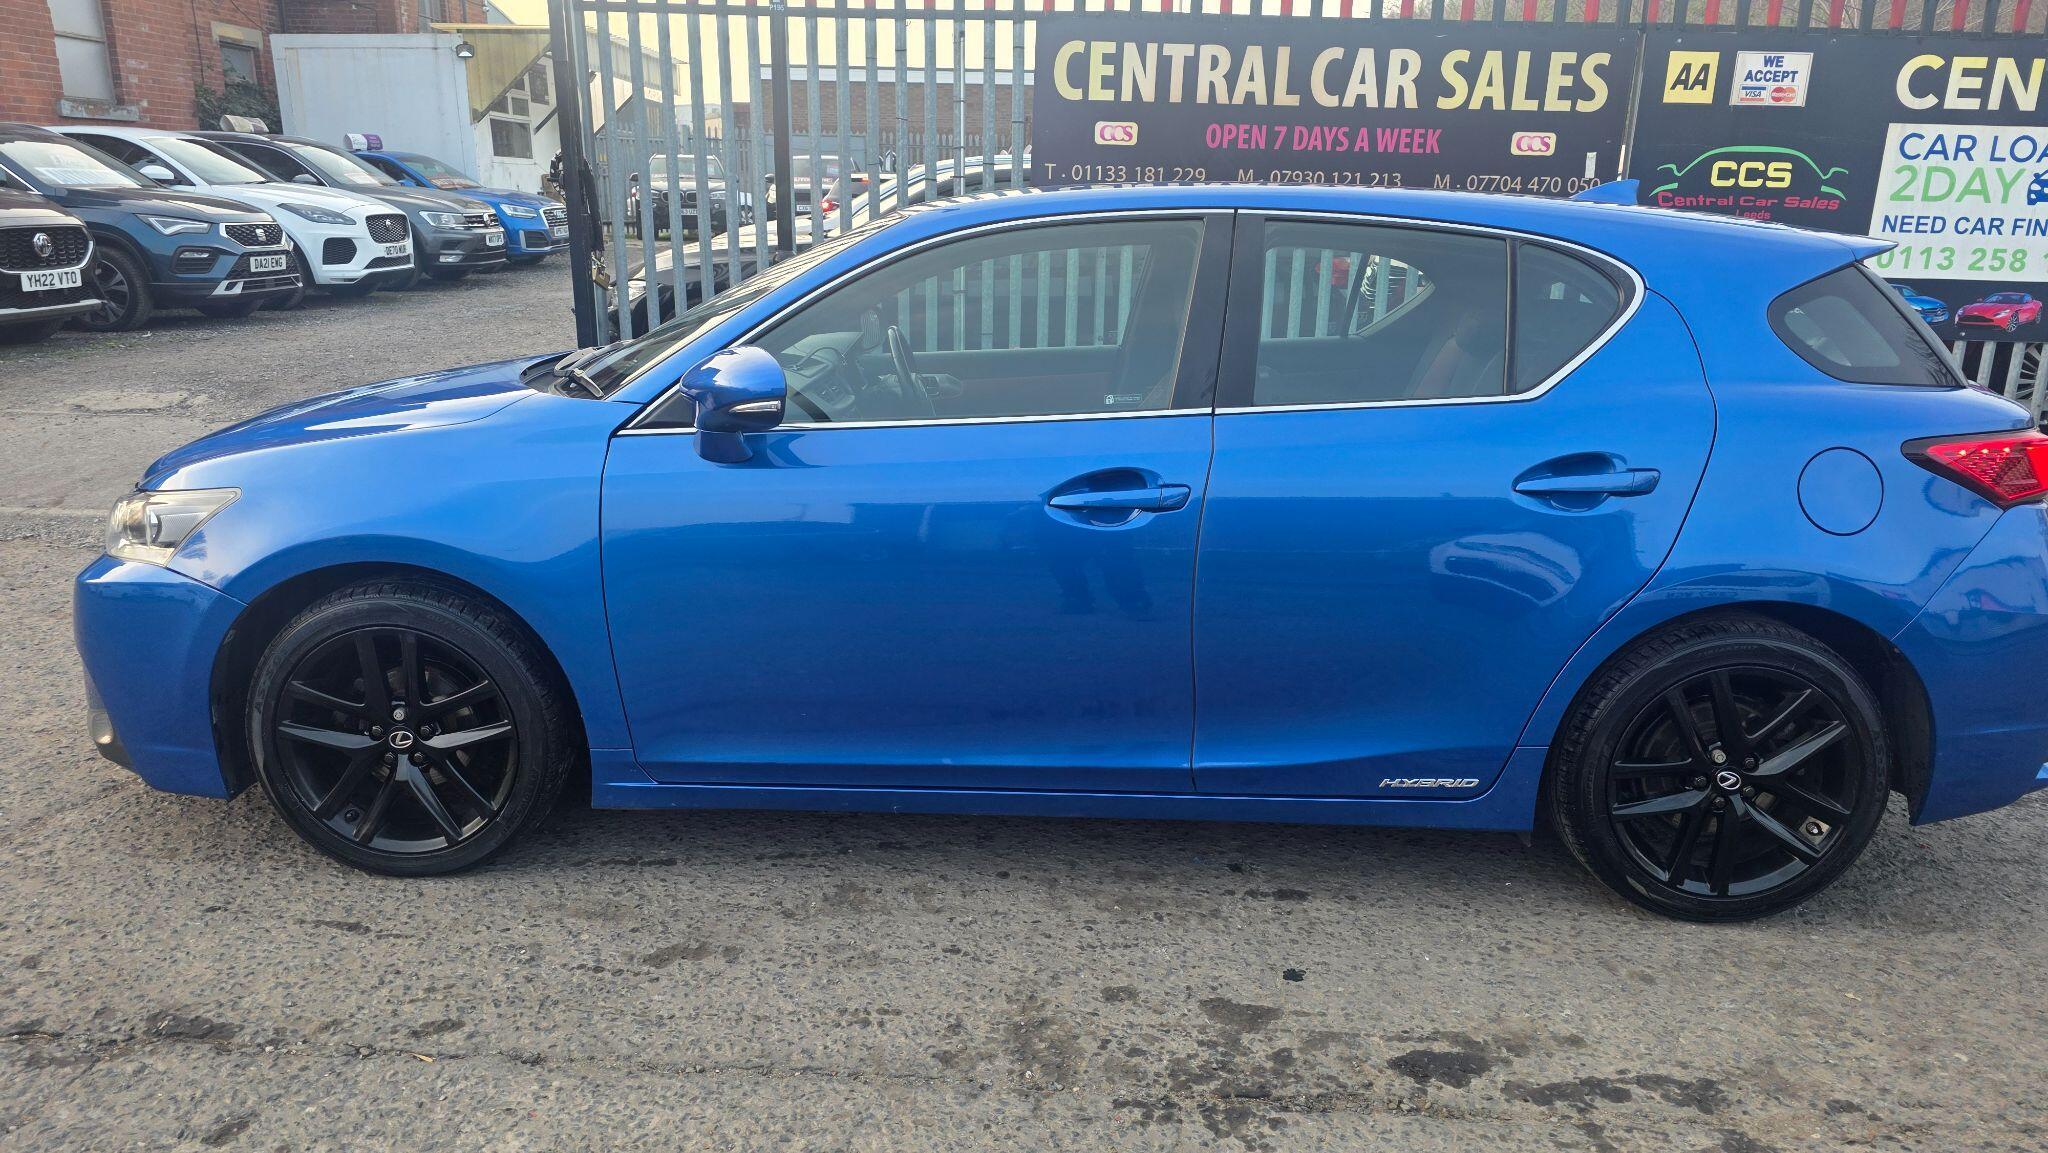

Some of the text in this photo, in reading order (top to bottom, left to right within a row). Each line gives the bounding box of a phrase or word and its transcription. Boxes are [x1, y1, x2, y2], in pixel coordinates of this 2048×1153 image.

[1763, 55, 1785, 68] WE
[1053, 40, 1611, 113] CENTRAL CAR SALES
[1669, 63, 1711, 91] AA
[1743, 69, 1799, 83] ACCEPT
[1896, 54, 2047, 112] CEN
[1745, 90, 1762, 98] VISA
[1099, 124, 1134, 143] CCS
[1205, 123, 1442, 155] OPEN 7 DAYS A WEEK
[1515, 135, 1551, 152] CCS
[1898, 132, 1978, 162] CAR
[1071, 164, 1127, 182] 01133
[1135, 166, 1164, 182] 181
[1172, 167, 1206, 182] 229
[1269, 169, 1325, 184] 07930
[1331, 171, 1361, 185] 121
[1369, 172, 1402, 187] 213
[1710, 160, 1793, 188] CCS
[1466, 174, 1522, 192] 07704
[1527, 175, 1562, 193] 470
[1889, 164, 2027, 204] 2DAY
[1657, 190, 1841, 211] Central Car Sales
[1735, 208, 1772, 221] Leeds
[1881, 214, 2048, 237] NEED CAR FIN
[254, 257, 270, 269] DA21
[1876, 245, 1956, 271] 0113
[1967, 247, 2028, 273] 258
[26, 271, 78, 288] YH22 VTO
[1378, 778, 1480, 788] HYBRID
